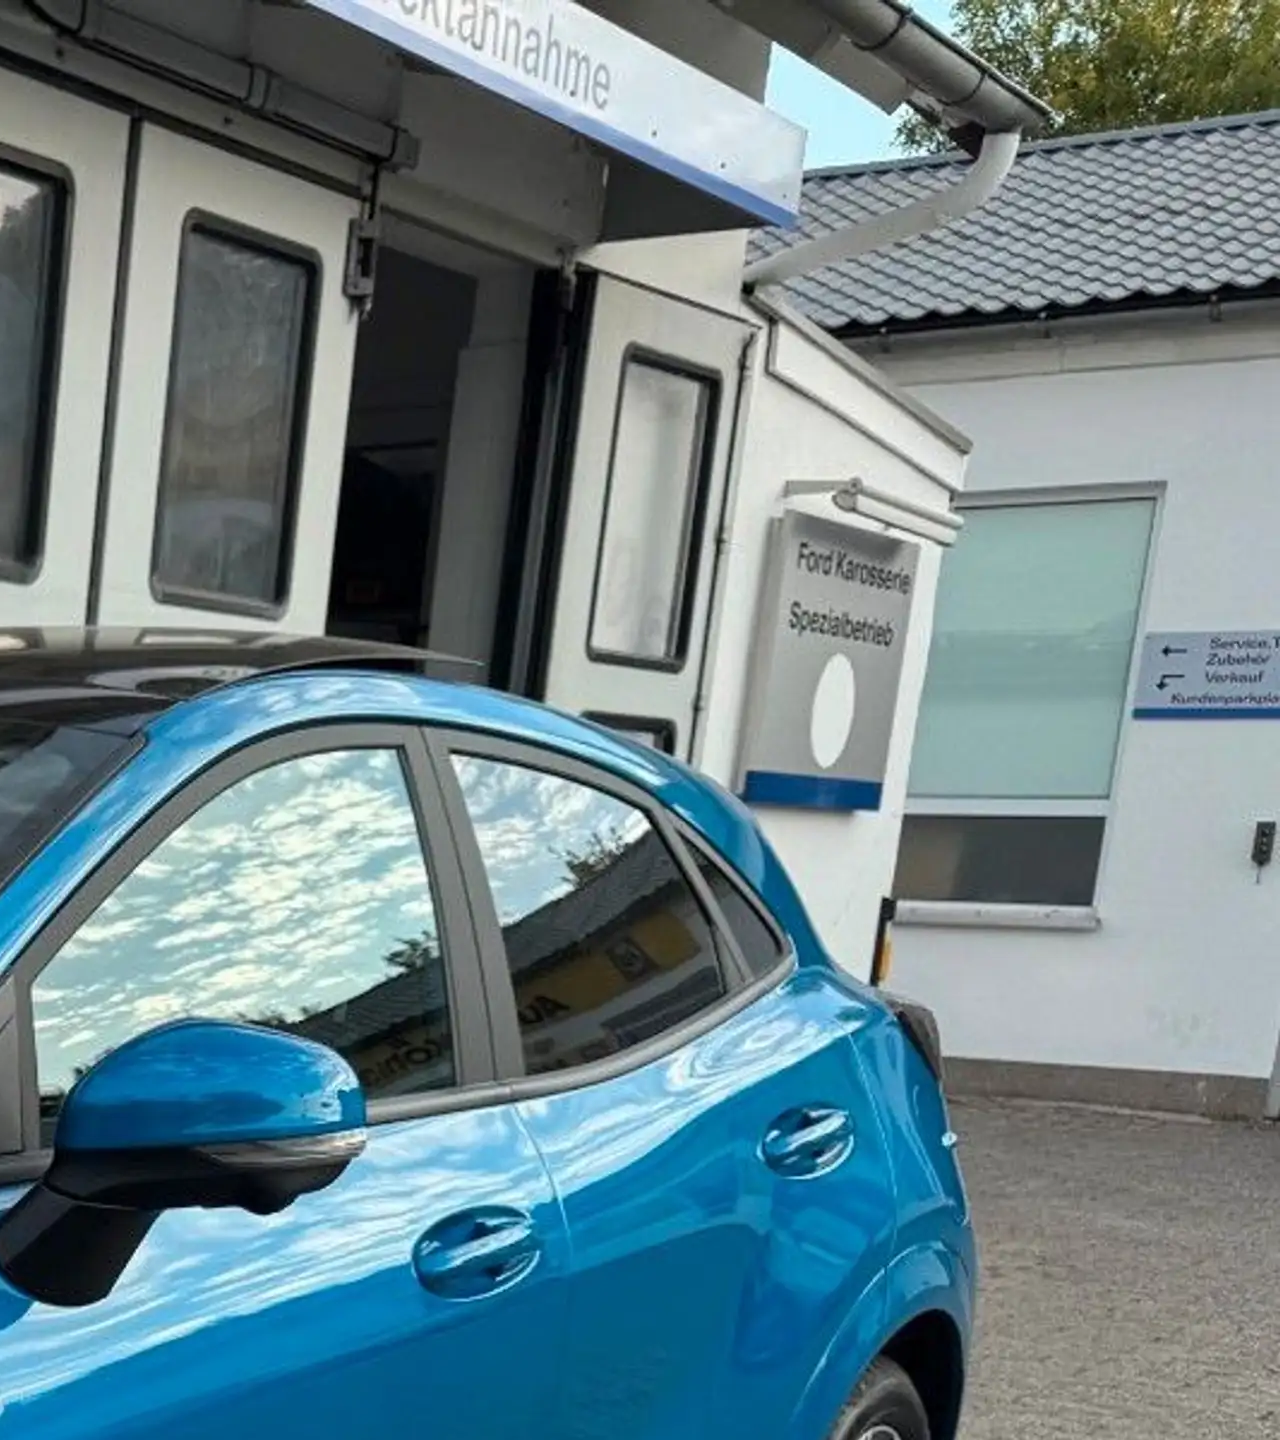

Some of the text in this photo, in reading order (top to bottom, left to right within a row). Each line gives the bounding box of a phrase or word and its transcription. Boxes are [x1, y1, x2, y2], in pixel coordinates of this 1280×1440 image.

[797, 541, 912, 595] Ford Karosserie
[788, 600, 895, 648] Spezialbetrieb
[1204, 670, 1265, 684] Verkauf
